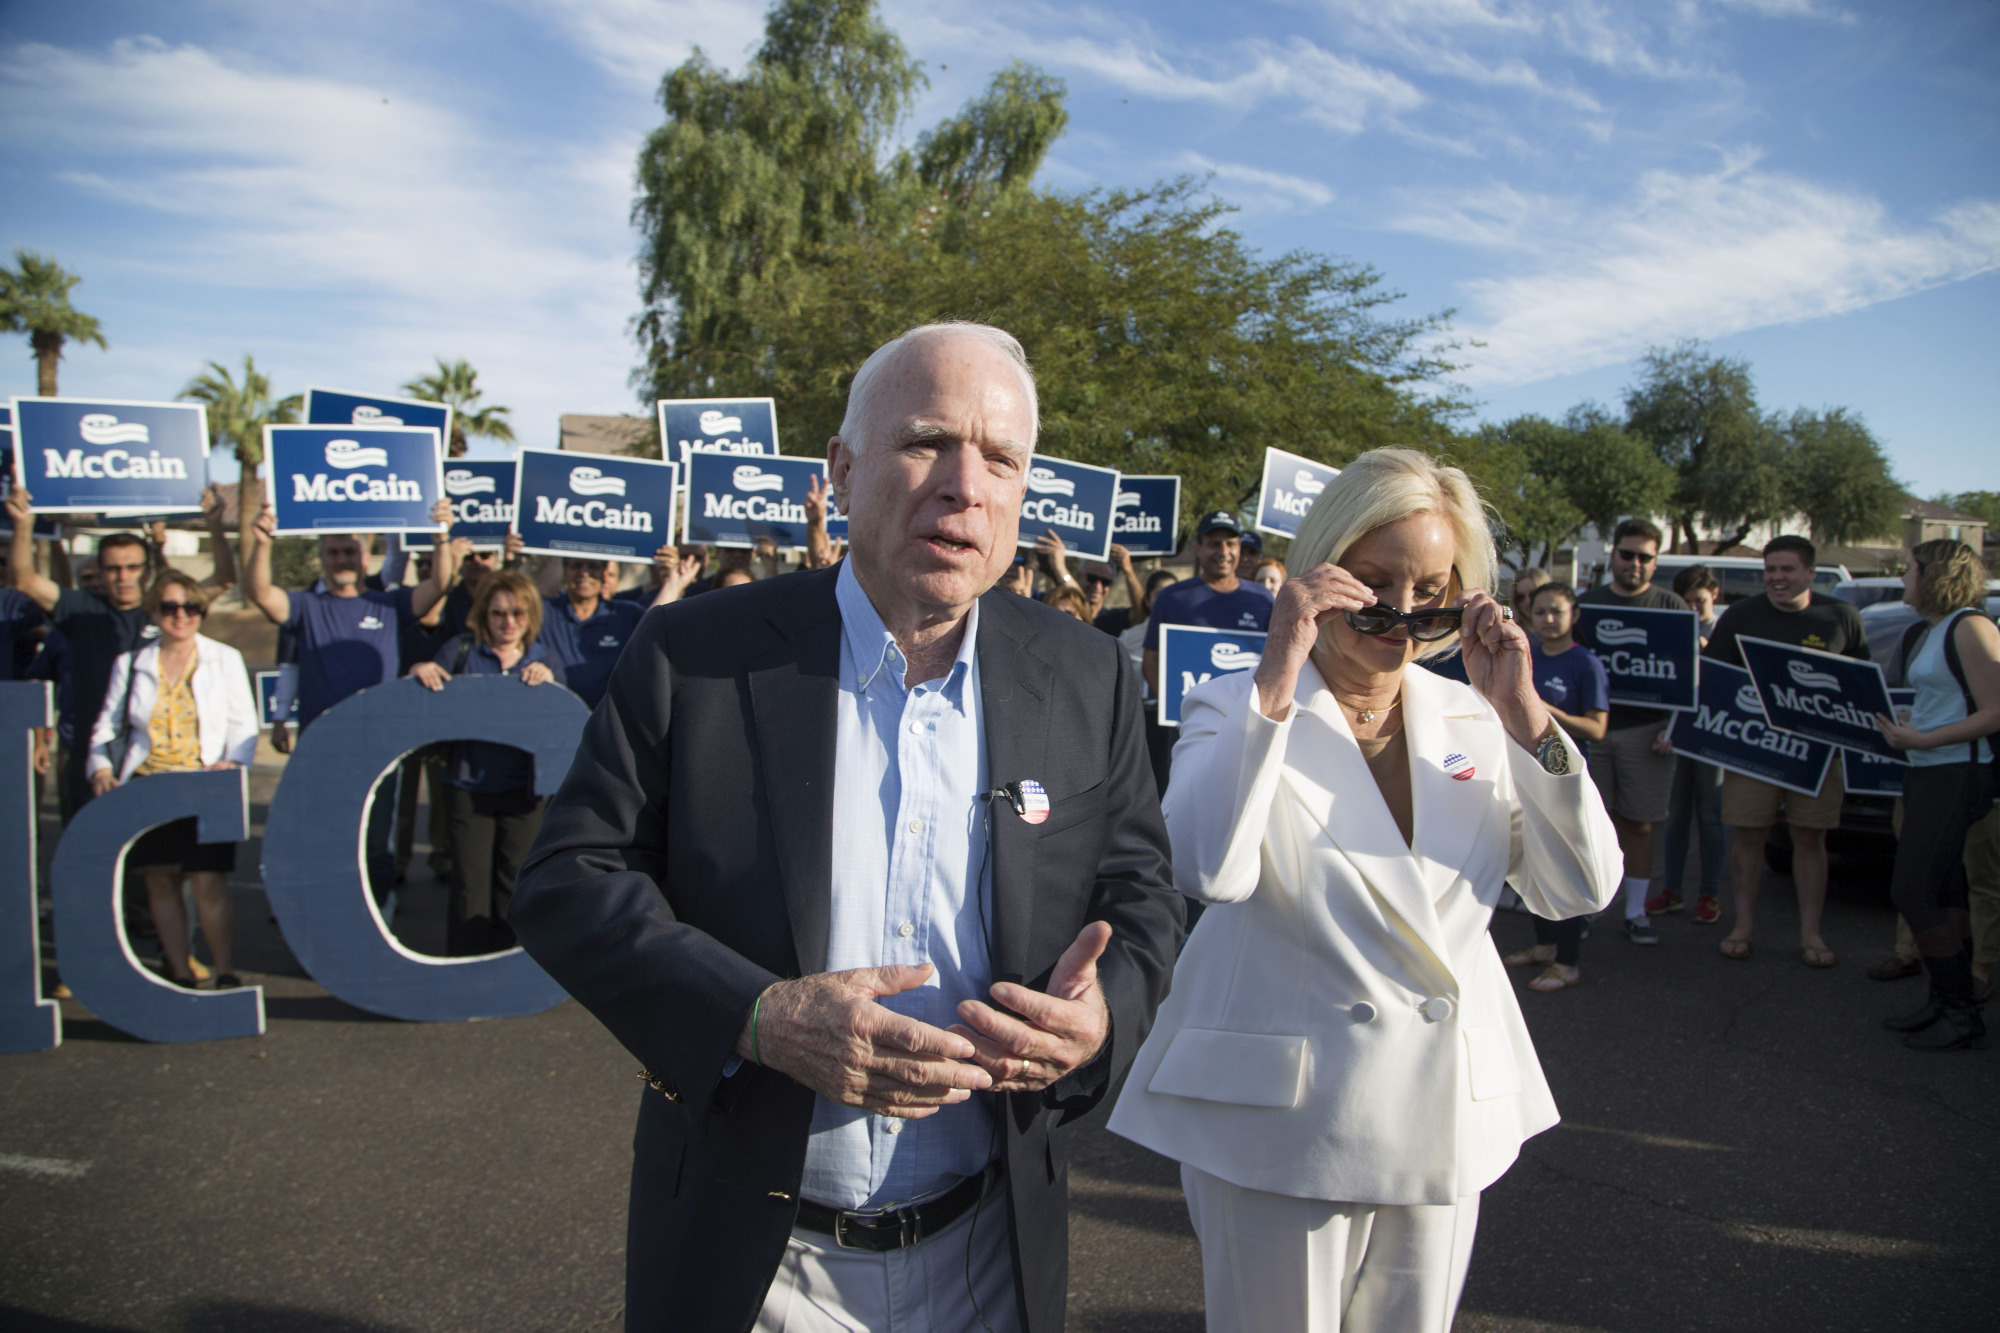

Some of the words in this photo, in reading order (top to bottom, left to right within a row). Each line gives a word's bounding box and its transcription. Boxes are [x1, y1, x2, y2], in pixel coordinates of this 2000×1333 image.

[43, 448, 188, 480] McCain
[292, 473, 423, 502] McCain
[1272, 487, 1314, 517] McC
[534, 495, 653, 533] McCain
[703, 492, 809, 525] McCain
[1019, 498, 1095, 532] cCain
[1112, 510, 1162, 533] Cain
[1596, 649, 1677, 681] cCain
[1769, 683, 1882, 733] McCain
[1693, 704, 1810, 761] McCain
